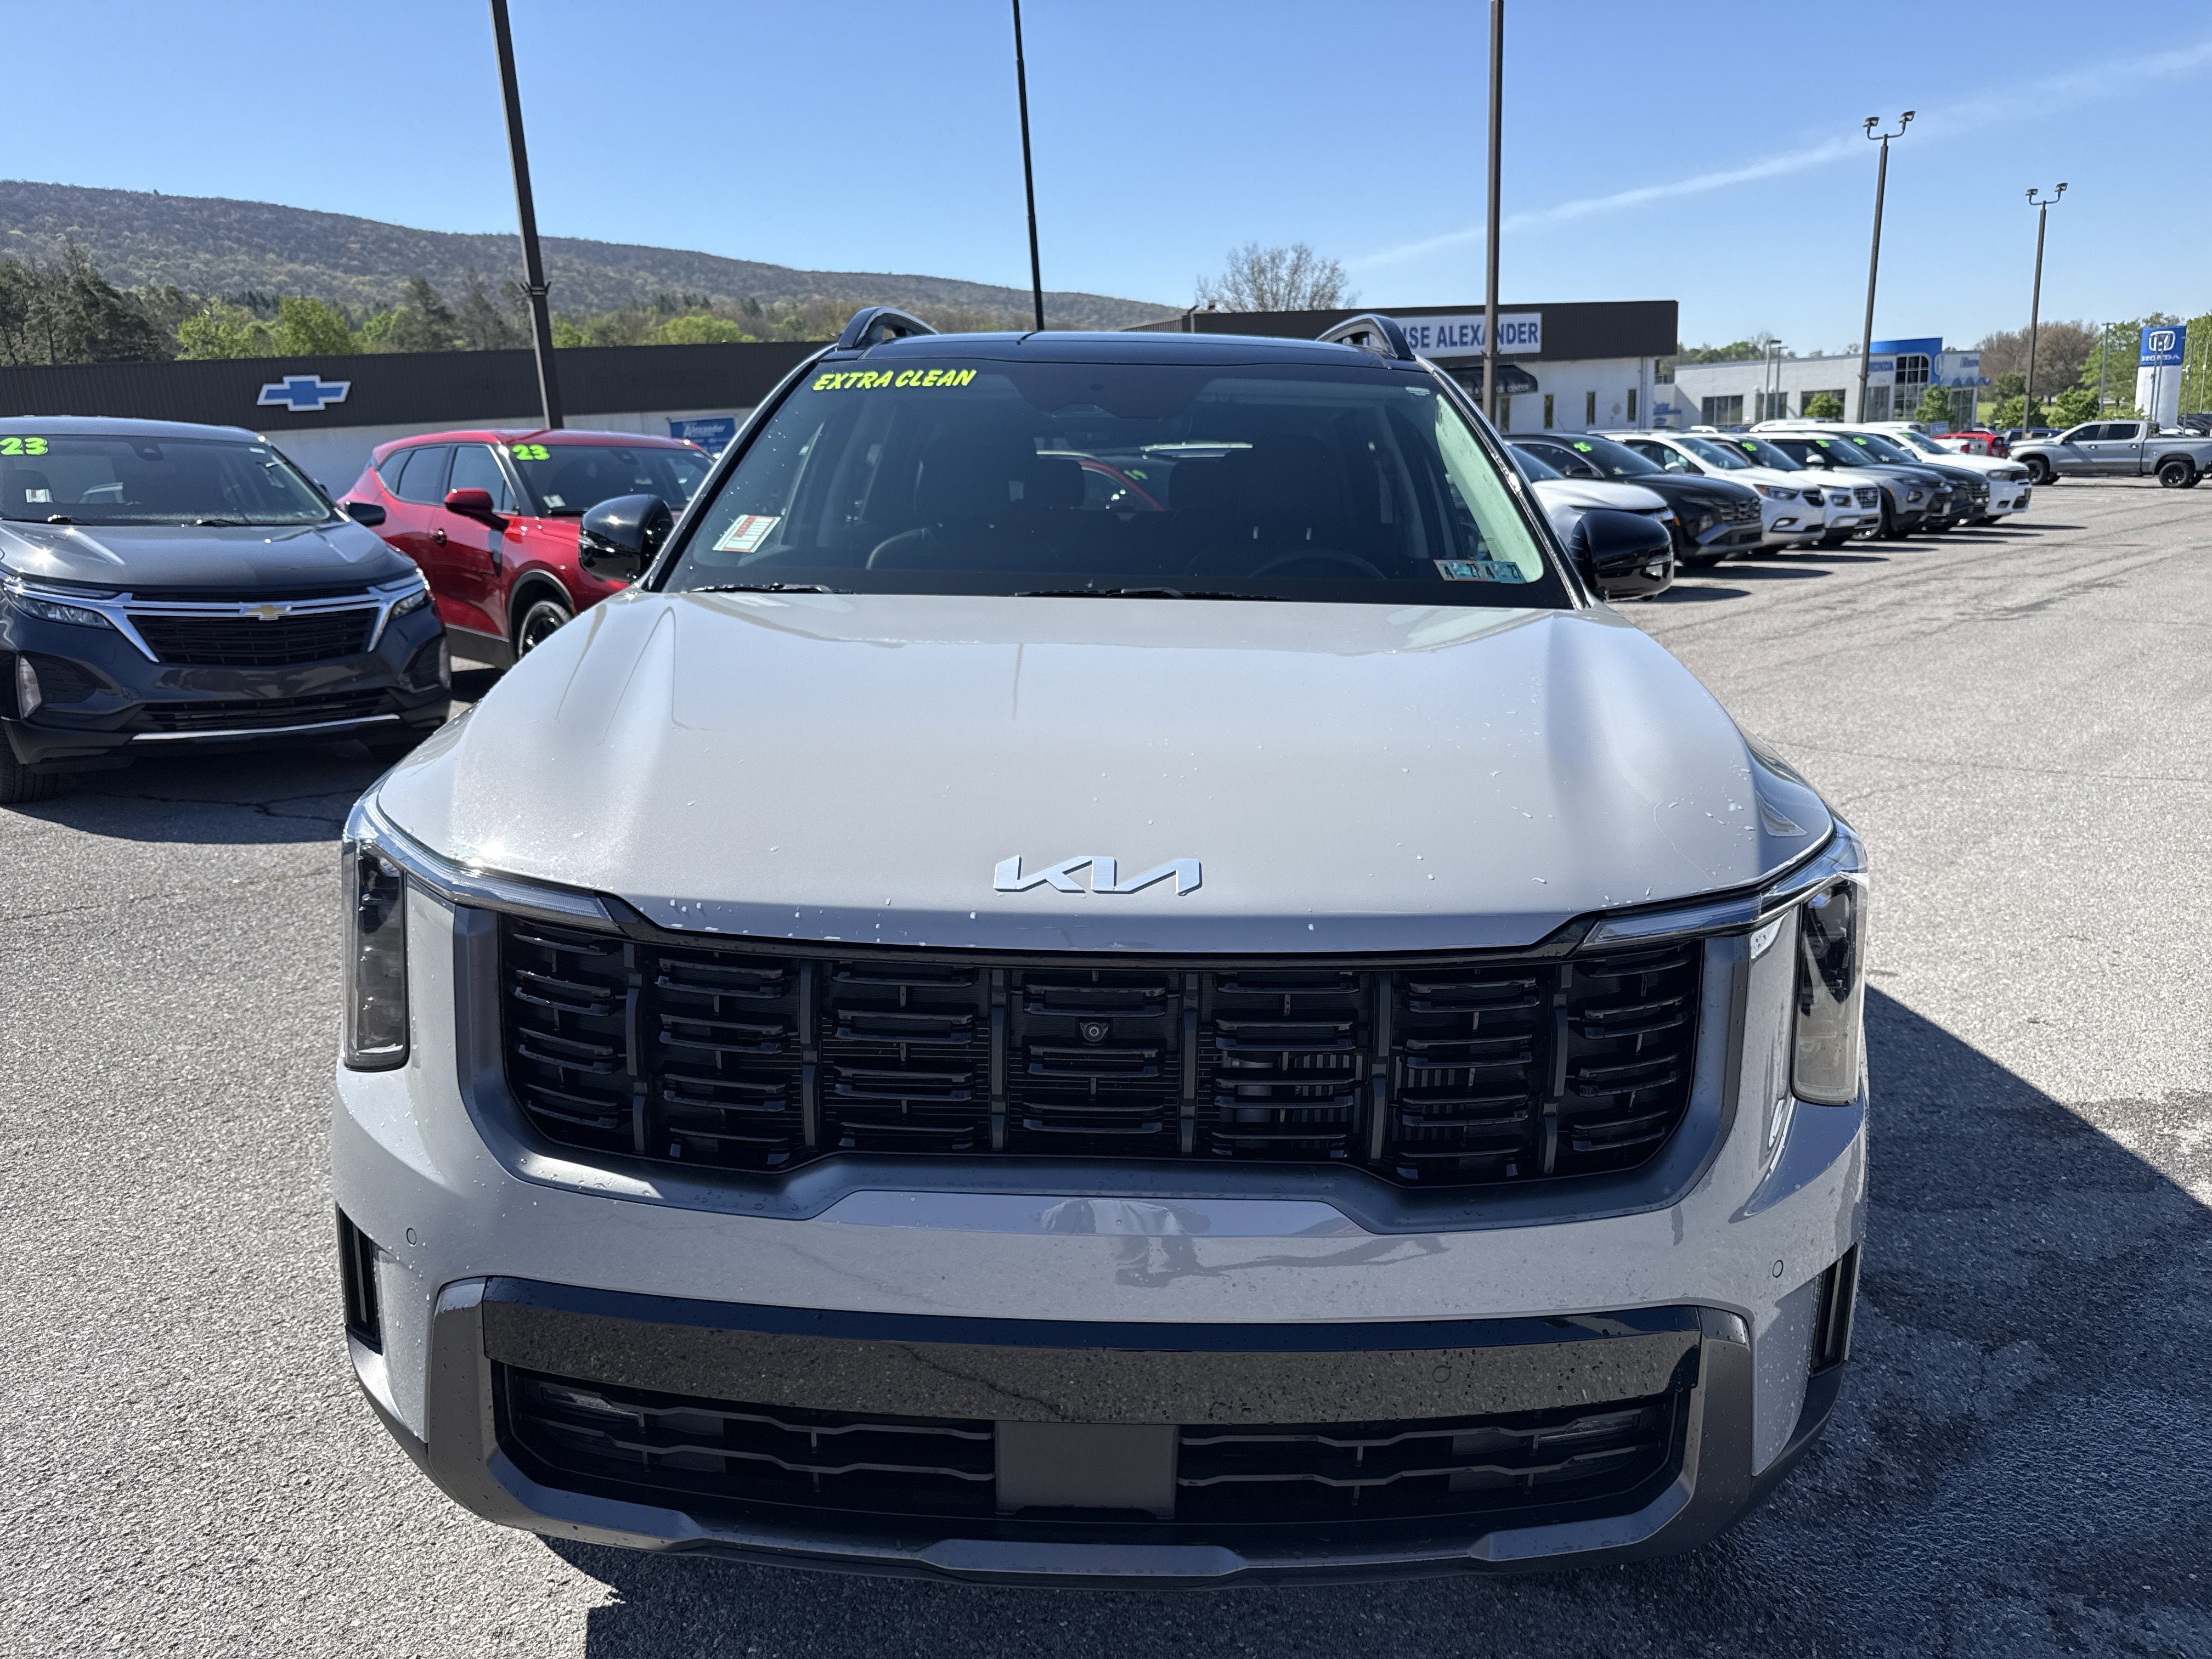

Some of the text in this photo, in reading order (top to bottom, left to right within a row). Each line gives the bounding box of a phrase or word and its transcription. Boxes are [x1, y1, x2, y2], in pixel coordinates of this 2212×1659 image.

[1436, 322, 1538, 348] ALEXNDER
[812, 369, 977, 391] EXTRA CLEAN
[0, 437, 48, 455] 23
[512, 444, 550, 460] 23
